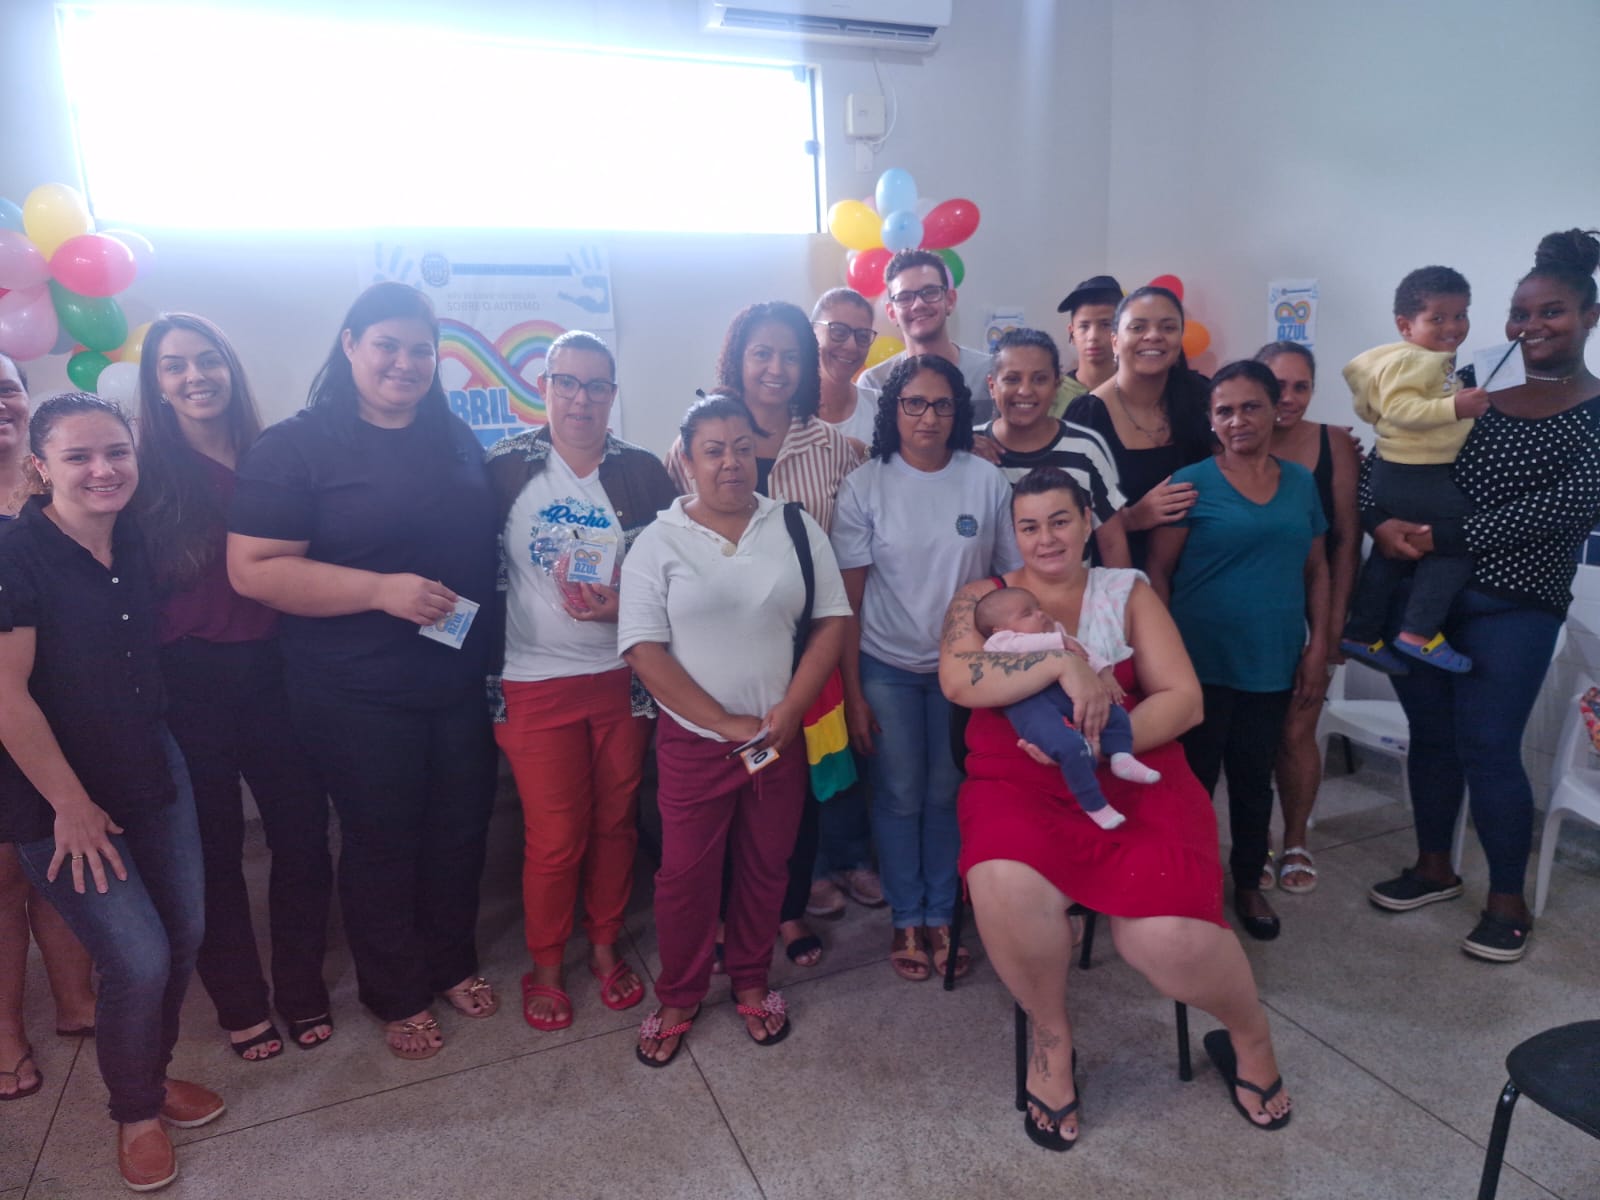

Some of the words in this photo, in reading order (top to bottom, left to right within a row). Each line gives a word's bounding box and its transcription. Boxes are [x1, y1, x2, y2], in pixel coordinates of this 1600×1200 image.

[1277, 324, 1308, 341] AZUL
[448, 387, 517, 425] BRIL
[546, 505, 611, 529] Rocha
[574, 562, 598, 576] AZUL
[447, 613, 465, 636] AZUL
